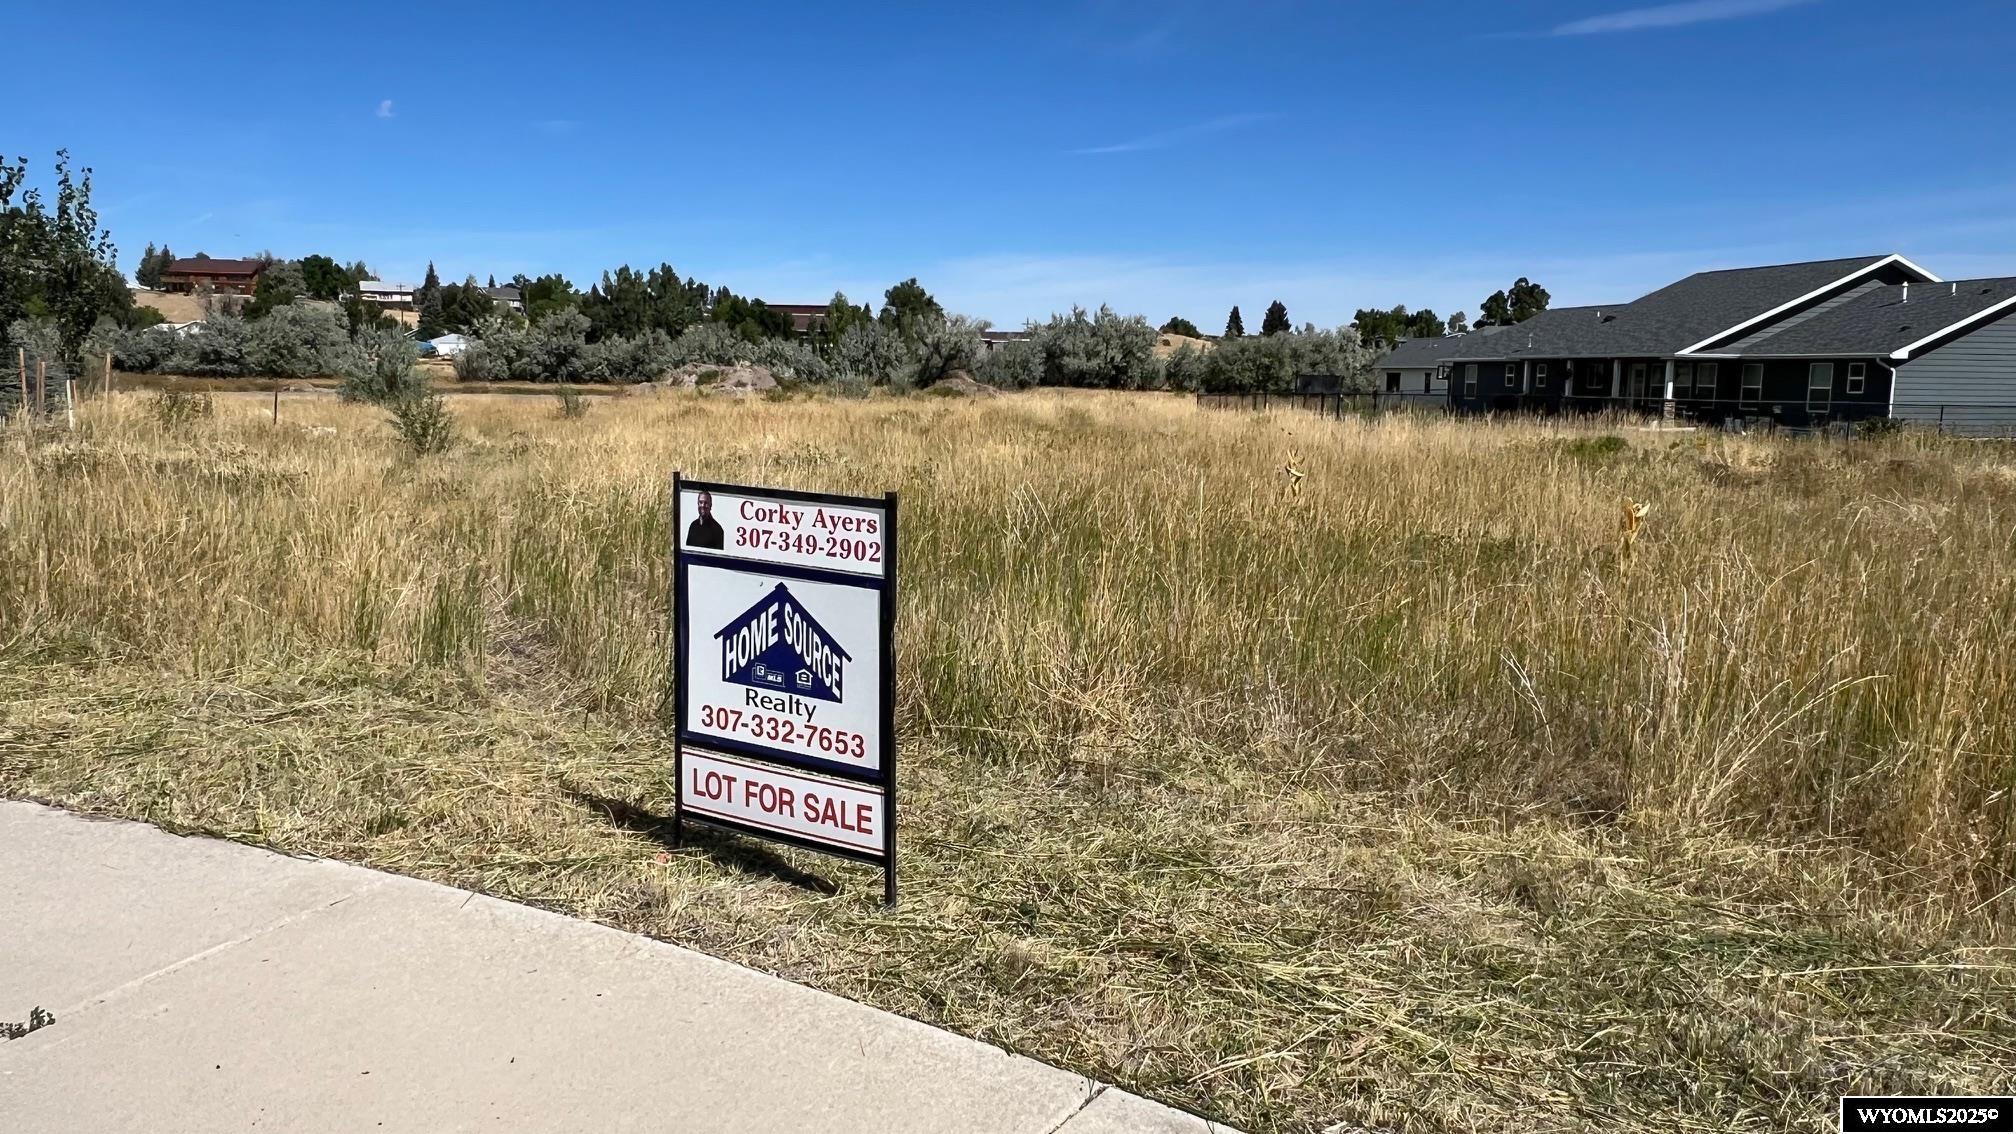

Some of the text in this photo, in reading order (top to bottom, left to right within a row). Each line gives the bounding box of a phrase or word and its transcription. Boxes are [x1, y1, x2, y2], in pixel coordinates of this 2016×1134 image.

[740, 500, 878, 535] Corky Ayers
[736, 526, 881, 563] 307-349-2902
[726, 602, 842, 699] HOME SOURCE
[745, 688, 817, 723] Realty
[701, 704, 865, 758] 307-332-7653
[693, 768, 873, 835] LOT FOR SALE
